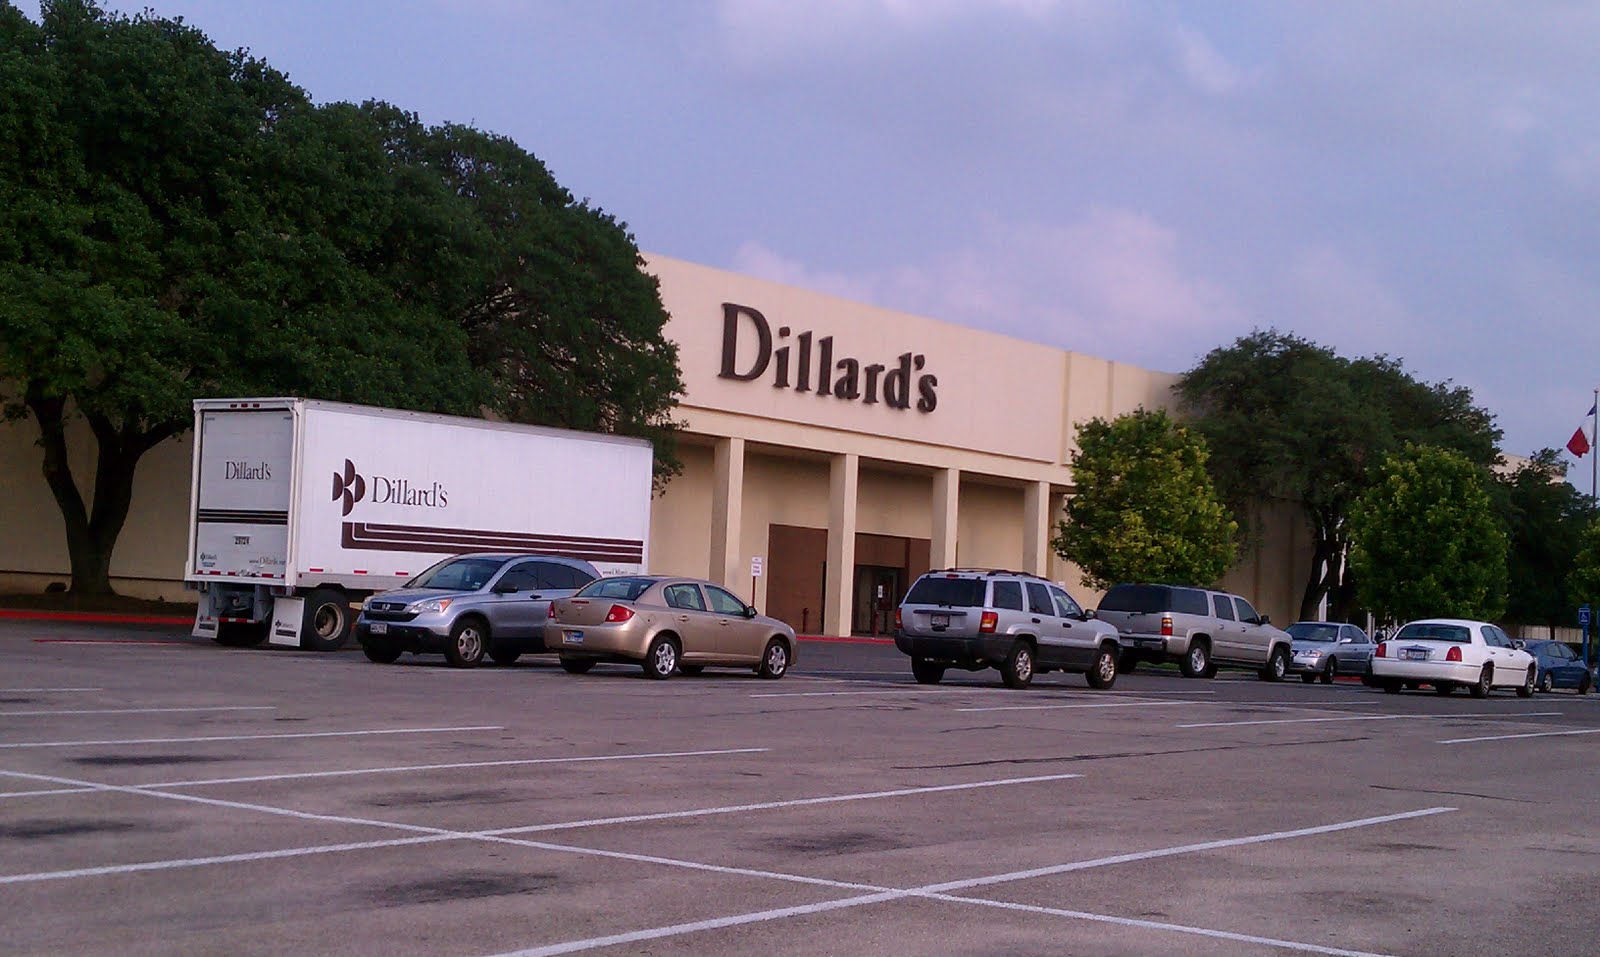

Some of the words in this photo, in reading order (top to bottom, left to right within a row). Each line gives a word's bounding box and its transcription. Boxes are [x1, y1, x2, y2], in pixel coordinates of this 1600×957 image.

[717, 302, 938, 413] Dillard's
[225, 461, 272, 480] Dillard's
[372, 476, 448, 508] Dillard's
